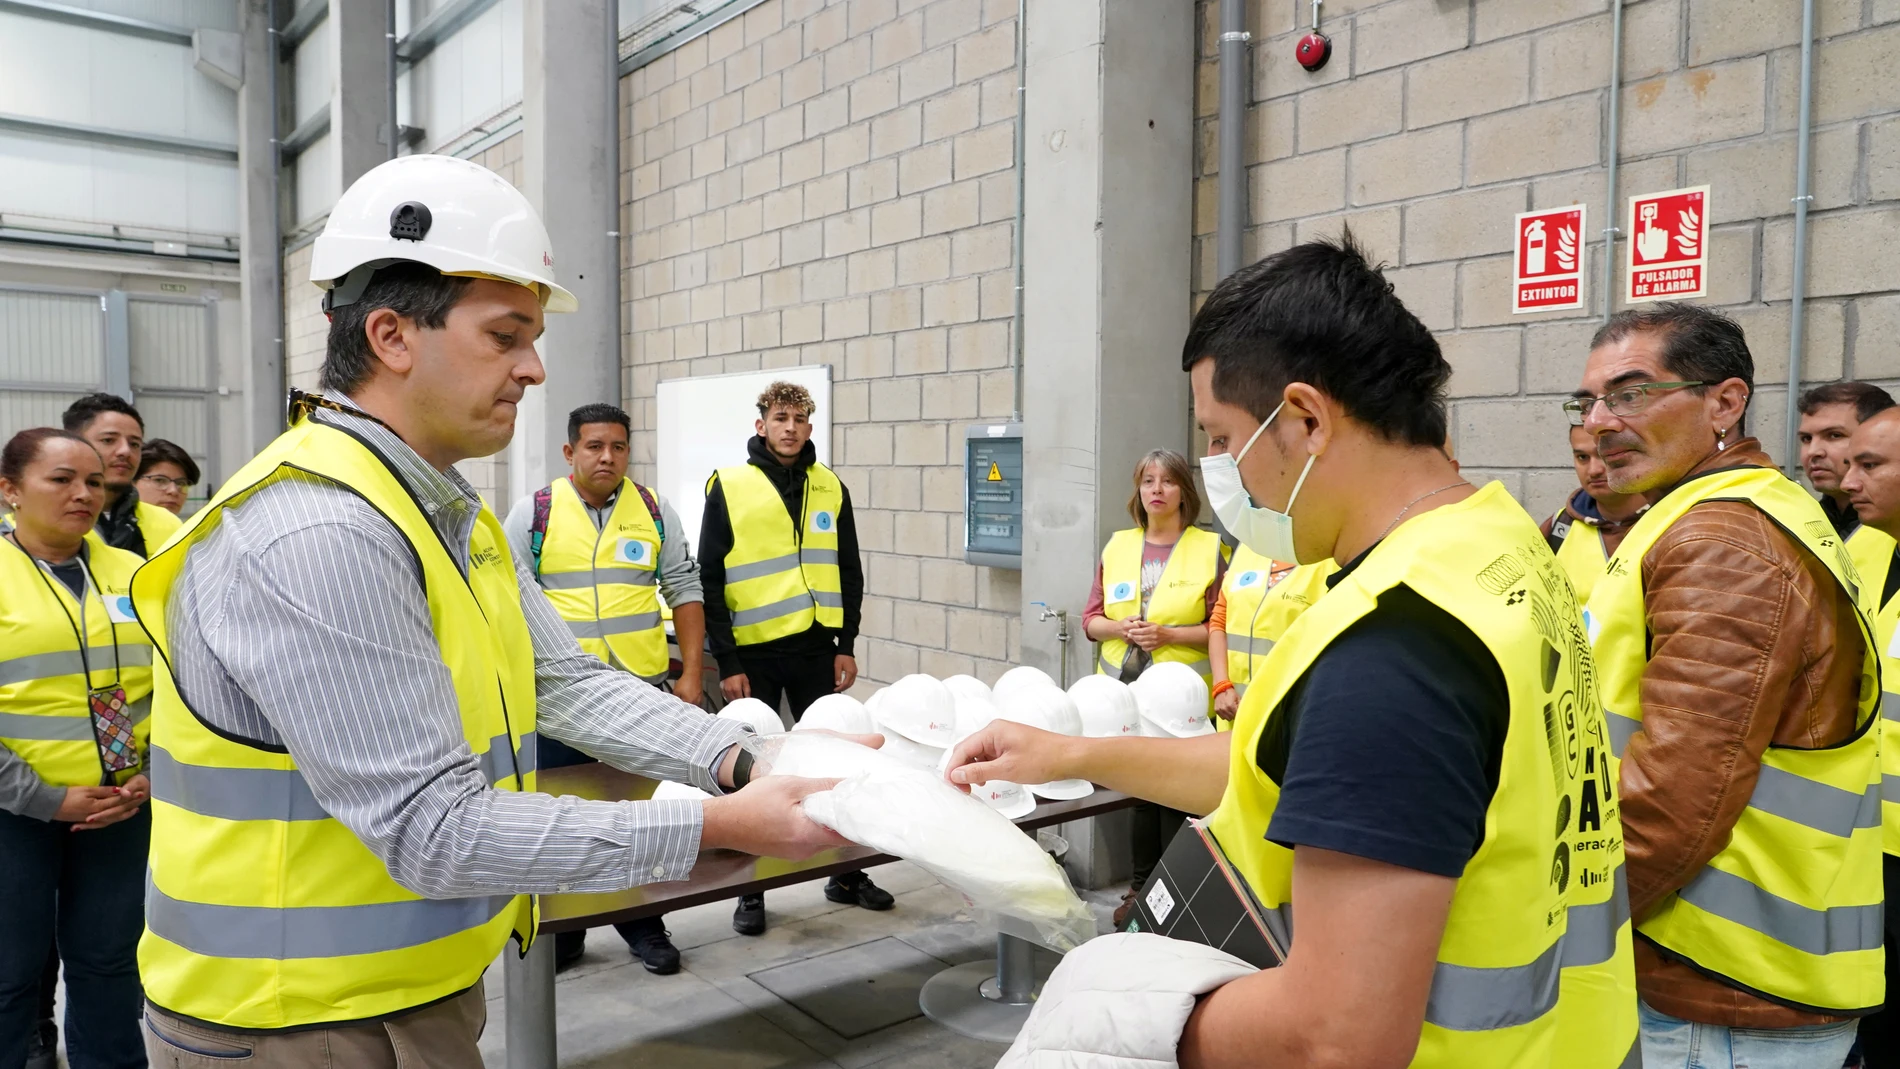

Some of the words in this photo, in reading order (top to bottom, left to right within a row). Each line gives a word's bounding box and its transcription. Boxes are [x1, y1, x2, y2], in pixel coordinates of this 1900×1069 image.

[1639, 268, 1694, 283] PULSADOR
[1521, 285, 1576, 301] EXTINTOR
[1635, 284, 1649, 295] DE
[1652, 279, 1697, 293] ALARMA
